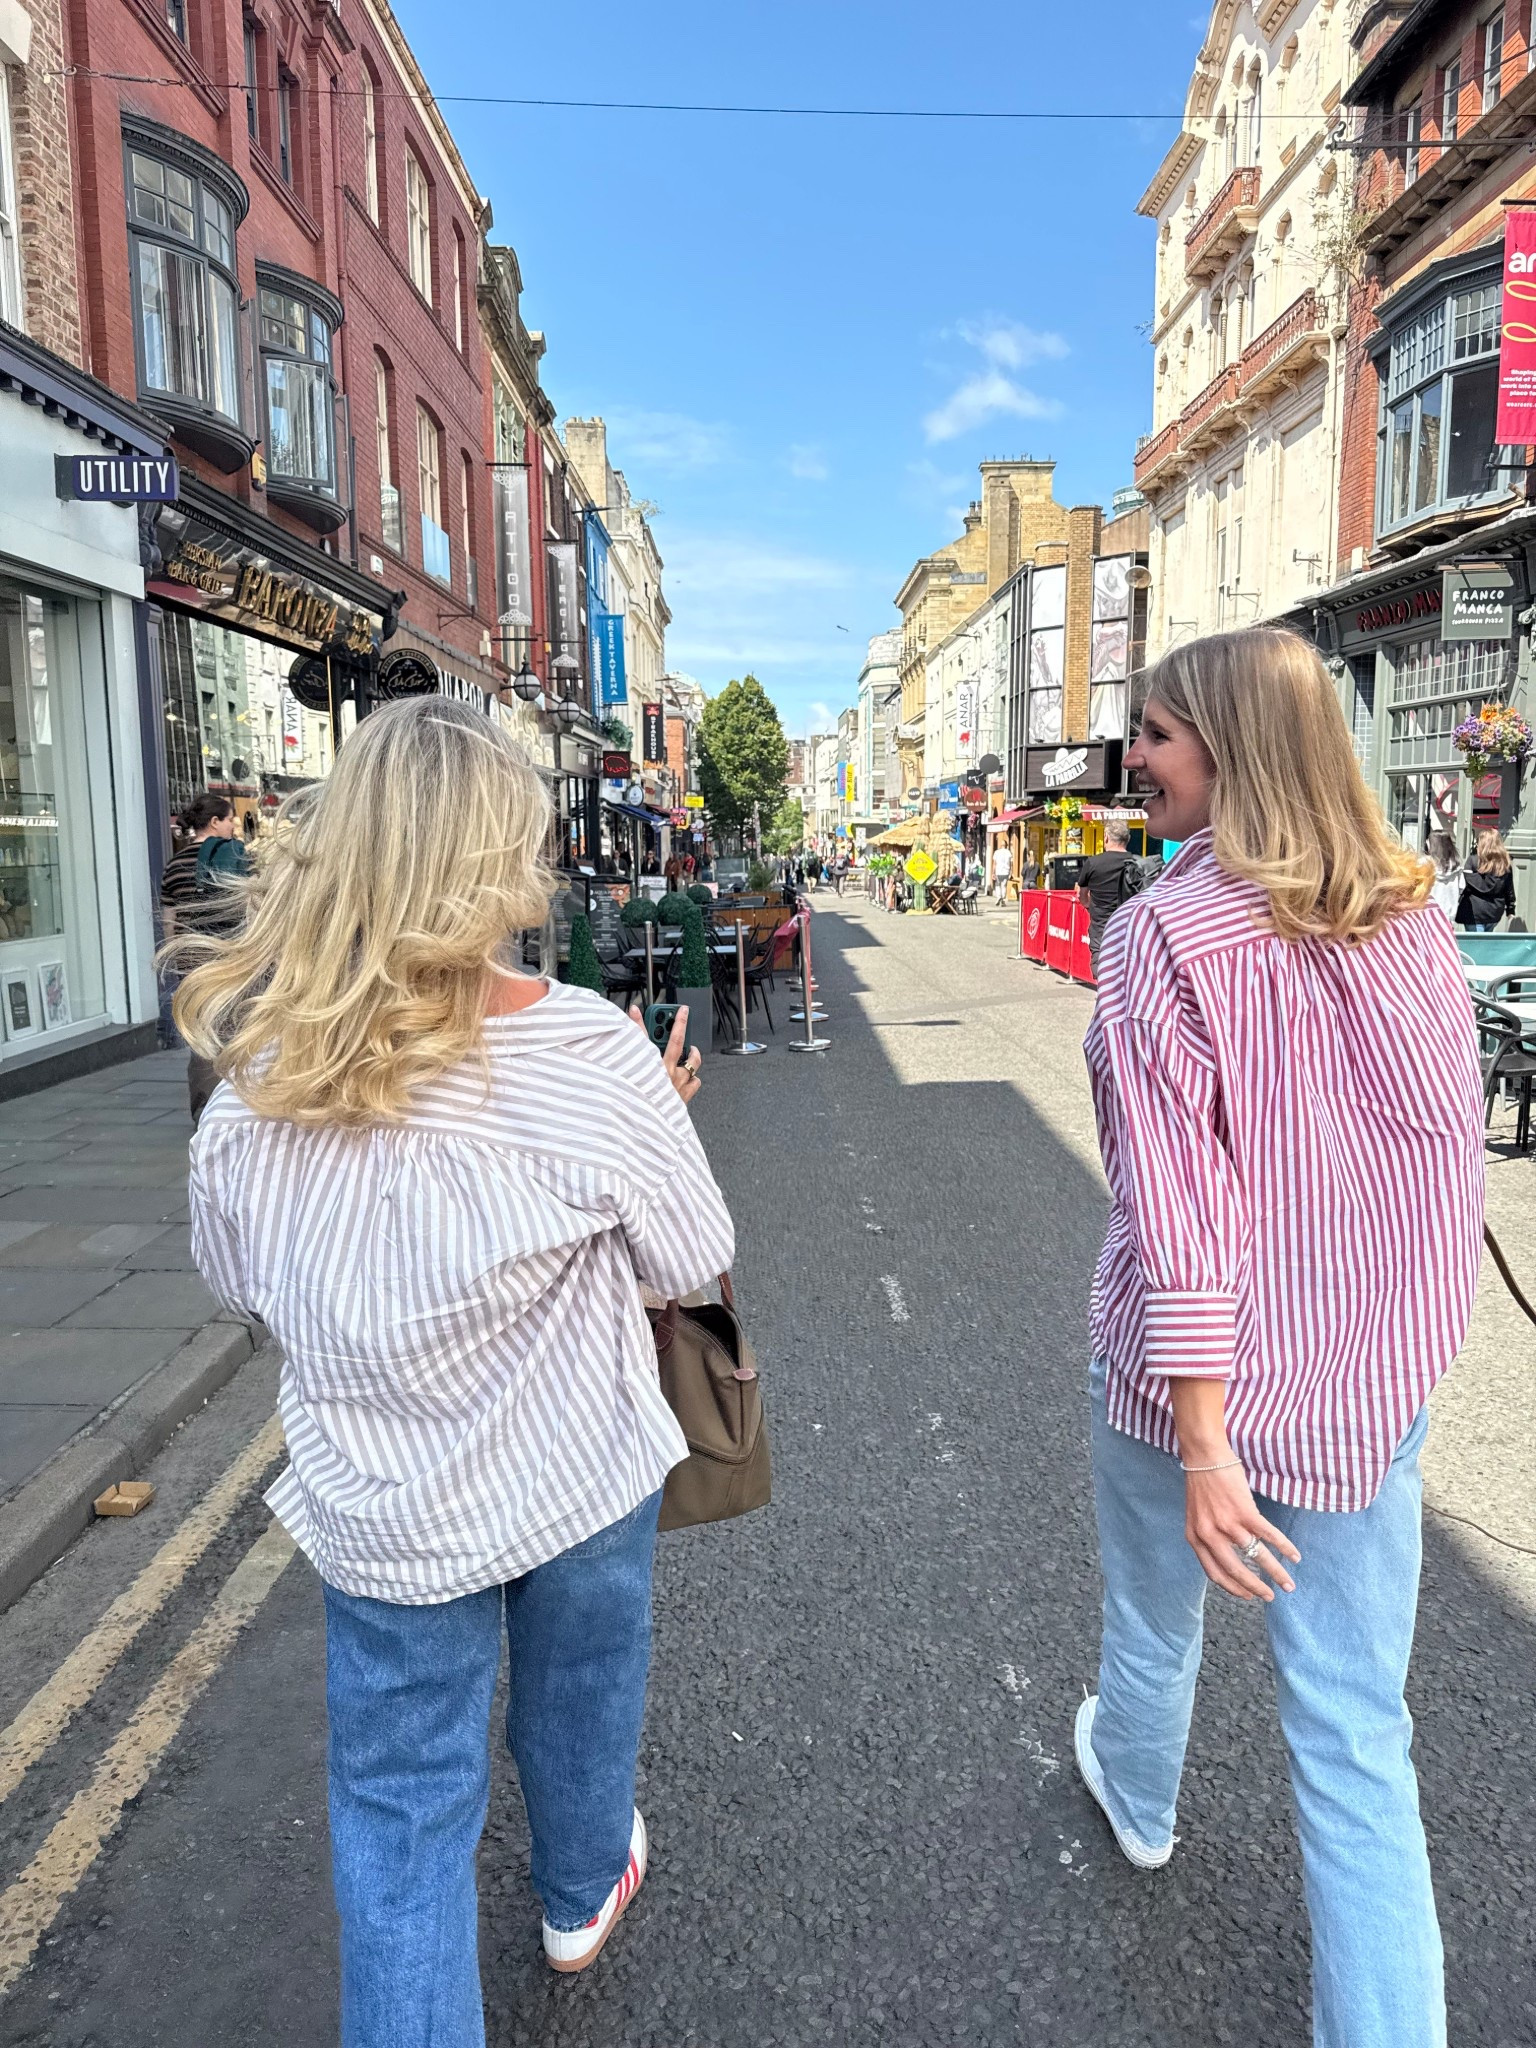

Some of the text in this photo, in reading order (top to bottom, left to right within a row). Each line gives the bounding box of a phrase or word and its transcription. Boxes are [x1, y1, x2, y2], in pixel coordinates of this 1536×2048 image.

[80, 460, 169, 493] UTILITY
[504, 490, 520, 606] TATTOO
[167, 560, 191, 584] BAR
[191, 569, 199, 585] &
[558, 560, 568, 652] PIERCING
[1453, 590, 1504, 602] FRANCO
[1453, 603, 1503, 615] MANCA
[1485, 617, 1504, 625] PIZZA
[607, 619, 619, 696] GREEK TAVERNA
[960, 693, 969, 728] ANAR
[1045, 775, 1056, 788] LA
[1091, 811, 1103, 820] LA
[1104, 811, 1141, 820] PARRILLA
